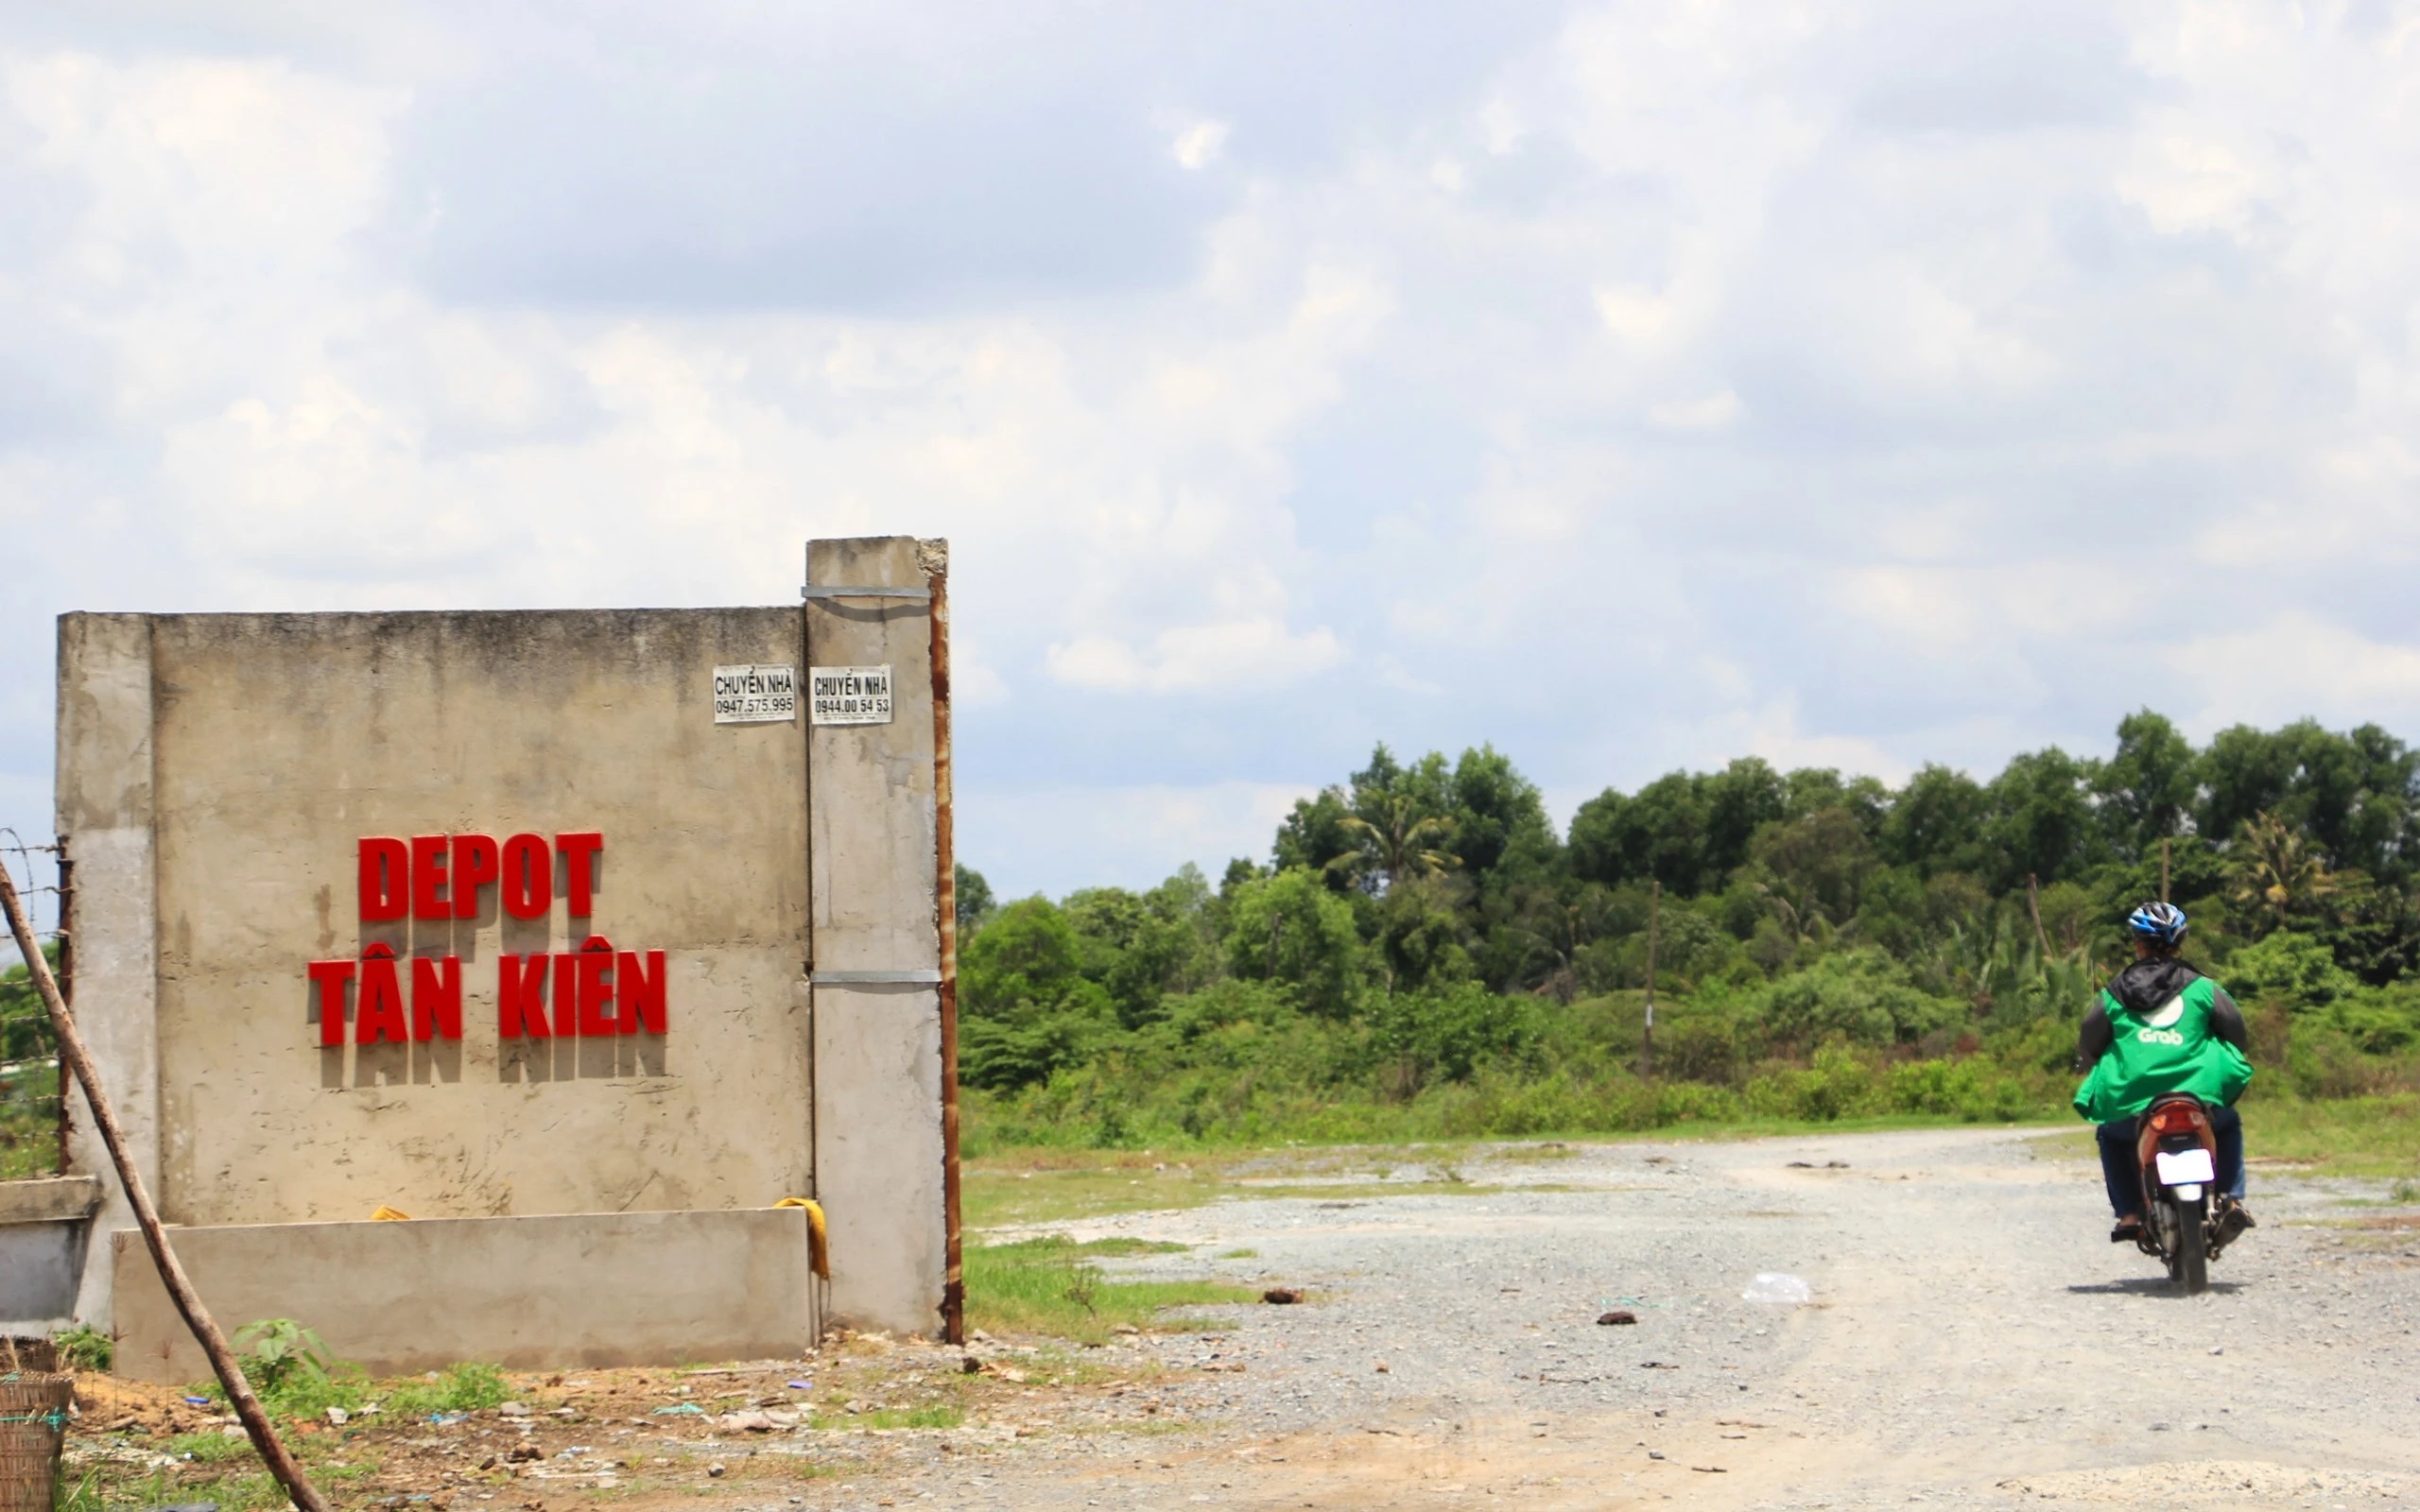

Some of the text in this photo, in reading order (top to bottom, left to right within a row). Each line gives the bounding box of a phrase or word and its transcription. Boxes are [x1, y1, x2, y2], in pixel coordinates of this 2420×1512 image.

[715, 665, 793, 696] CHUYỂN NHÀ
[814, 667, 888, 696] CHUYỂN NHÀ
[716, 697, 793, 713] 0947.575.995
[815, 698, 890, 713] 0944.00 54 53
[358, 833, 604, 921] DEPOT
[308, 934, 668, 1045] TÂN KIÊN
[2137, 1027, 2184, 1045] Grab
